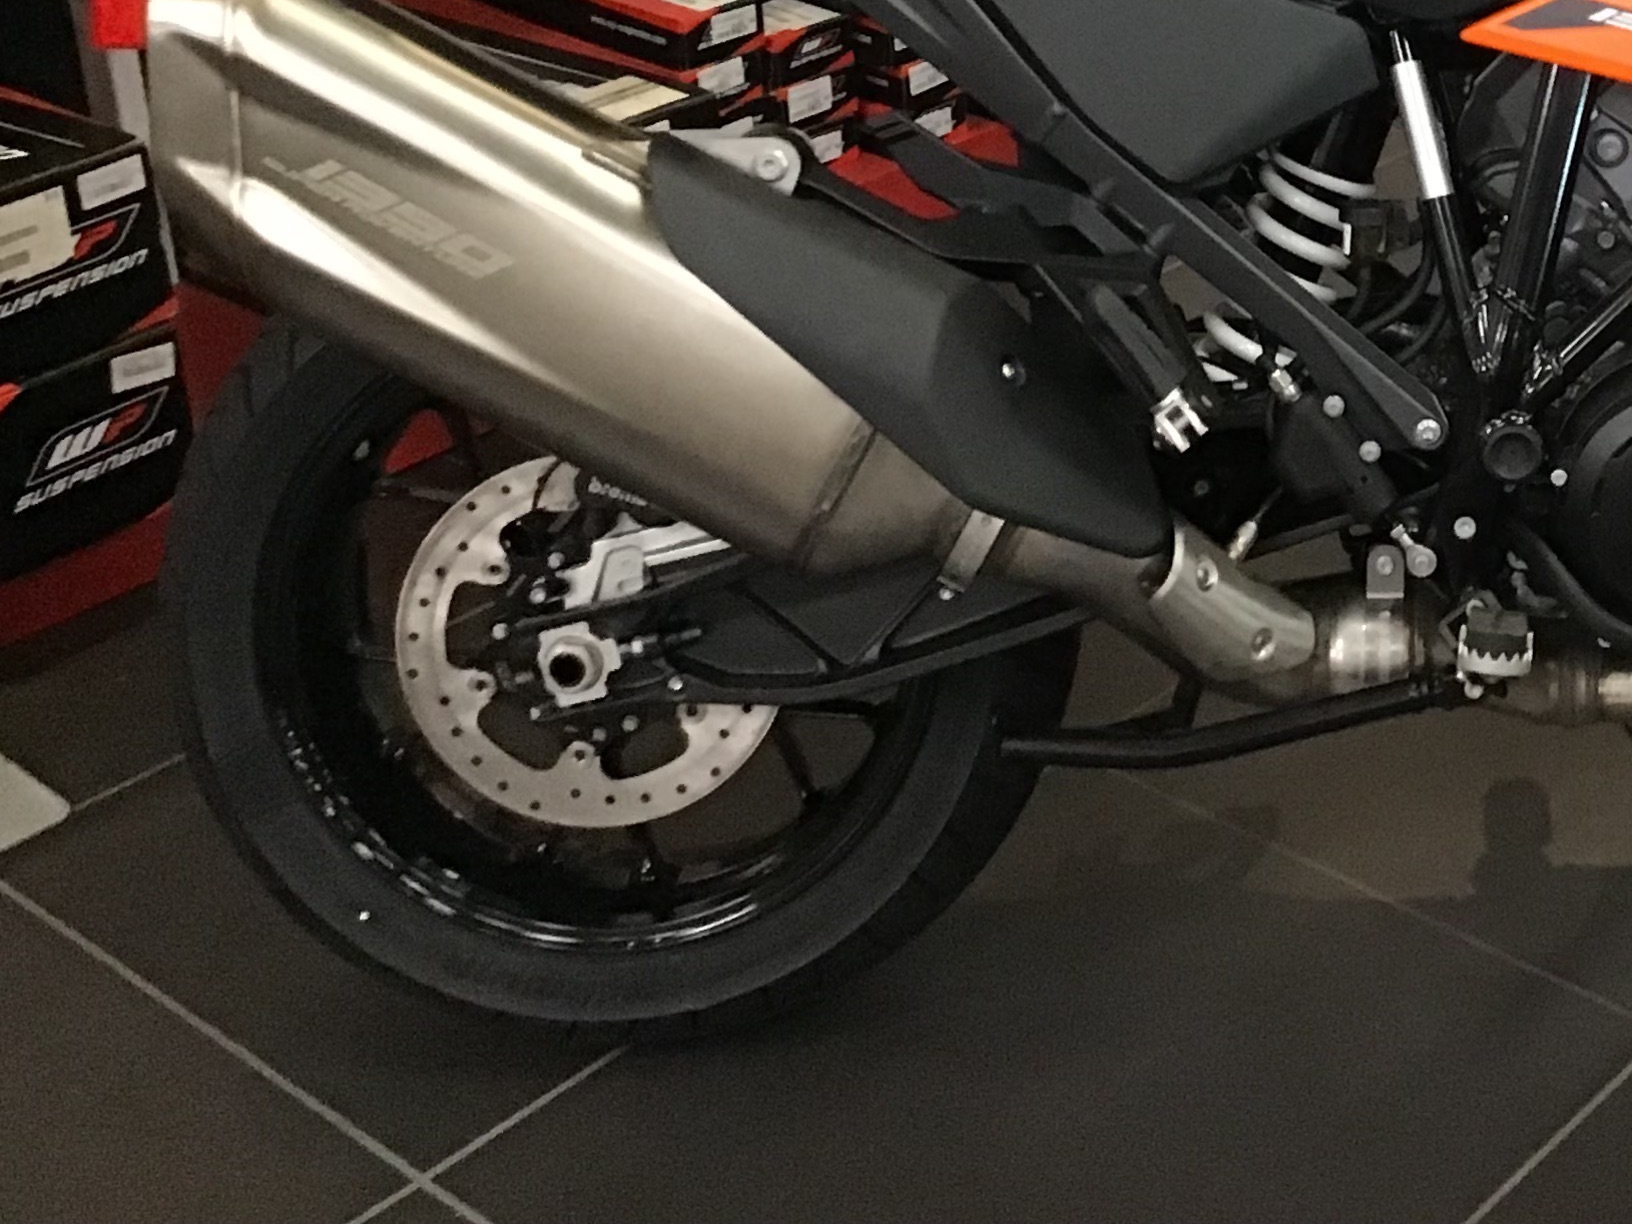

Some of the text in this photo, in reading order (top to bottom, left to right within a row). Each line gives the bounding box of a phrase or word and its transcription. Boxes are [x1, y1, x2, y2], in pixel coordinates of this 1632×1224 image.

[0, 248, 149, 319] USPENSION
[13, 428, 178, 514] SUSPENSION
[45, 403, 147, 470] WP
